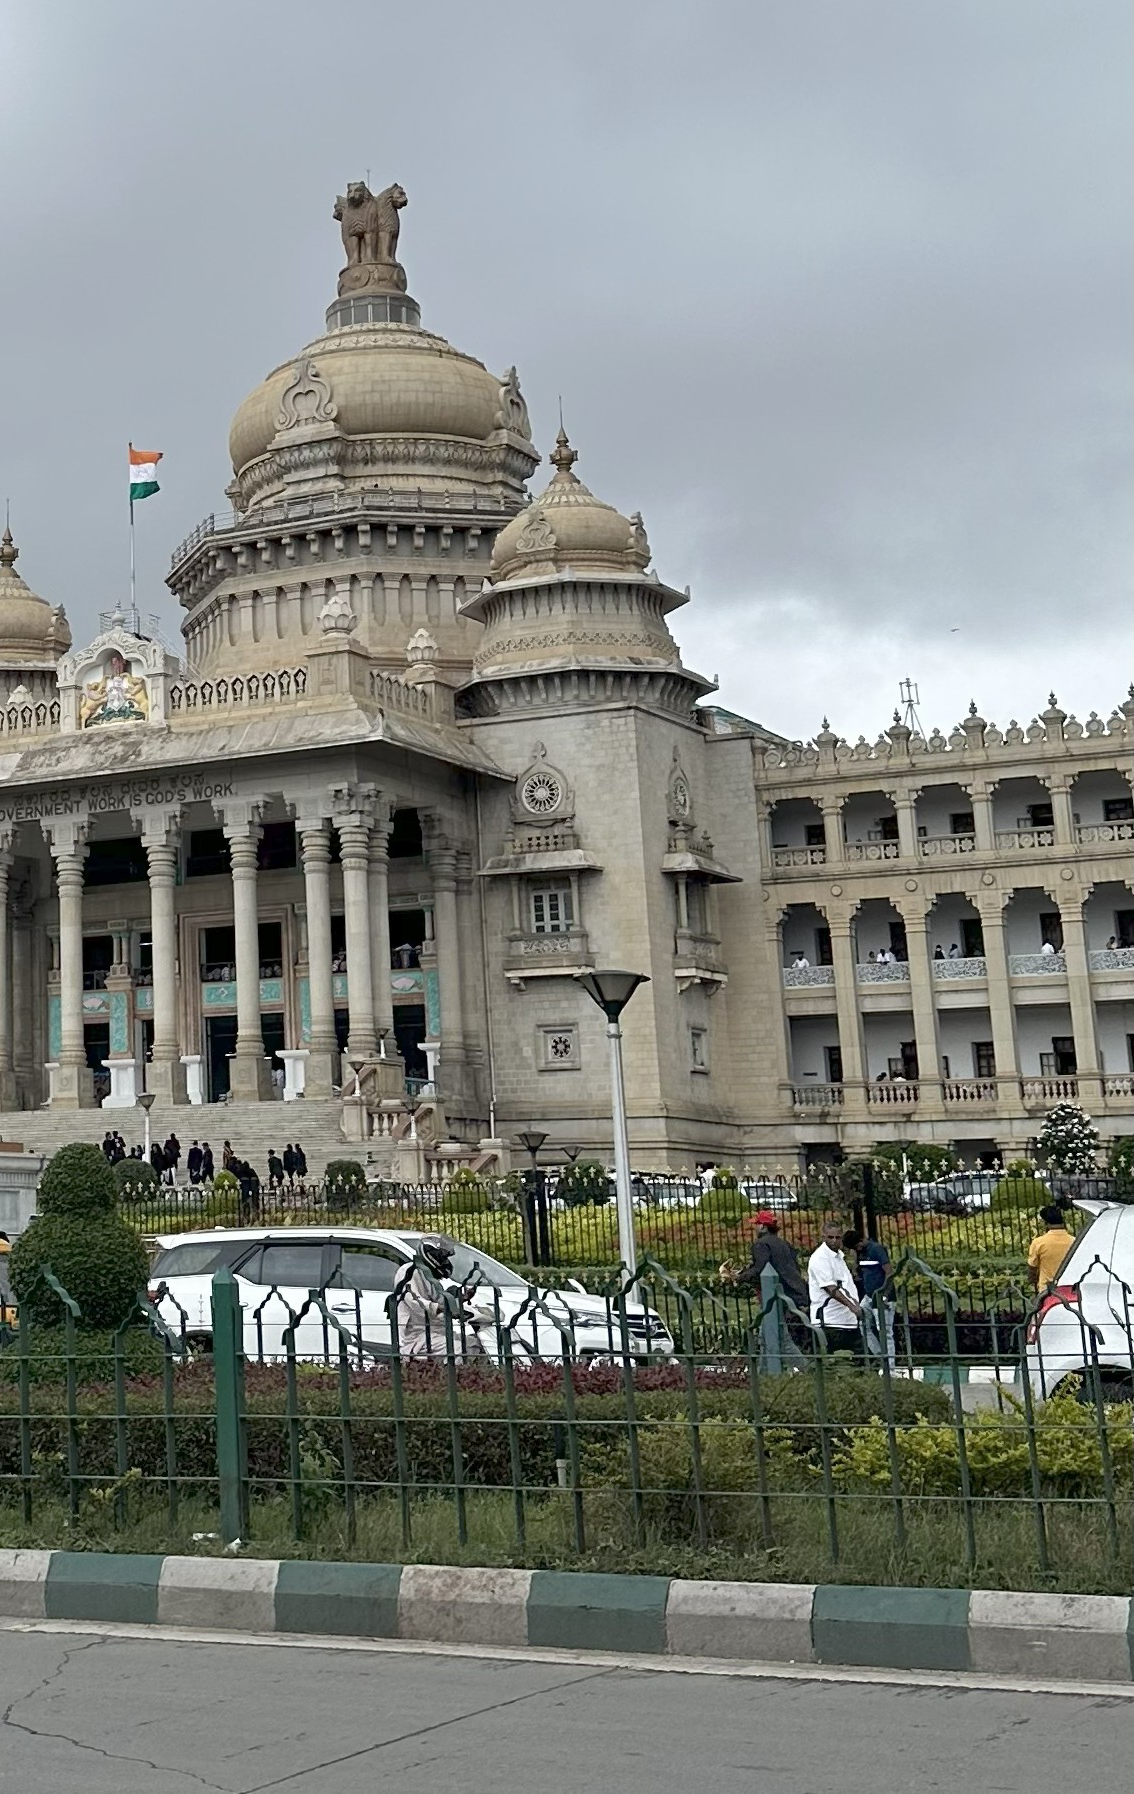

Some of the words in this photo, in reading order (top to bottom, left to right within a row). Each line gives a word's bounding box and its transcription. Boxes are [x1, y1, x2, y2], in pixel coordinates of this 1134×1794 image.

[88, 795, 125, 811] WORK
[130, 793, 142, 807] IS
[146, 789, 186, 805] GOD'S
[192, 782, 233, 800] WORK
